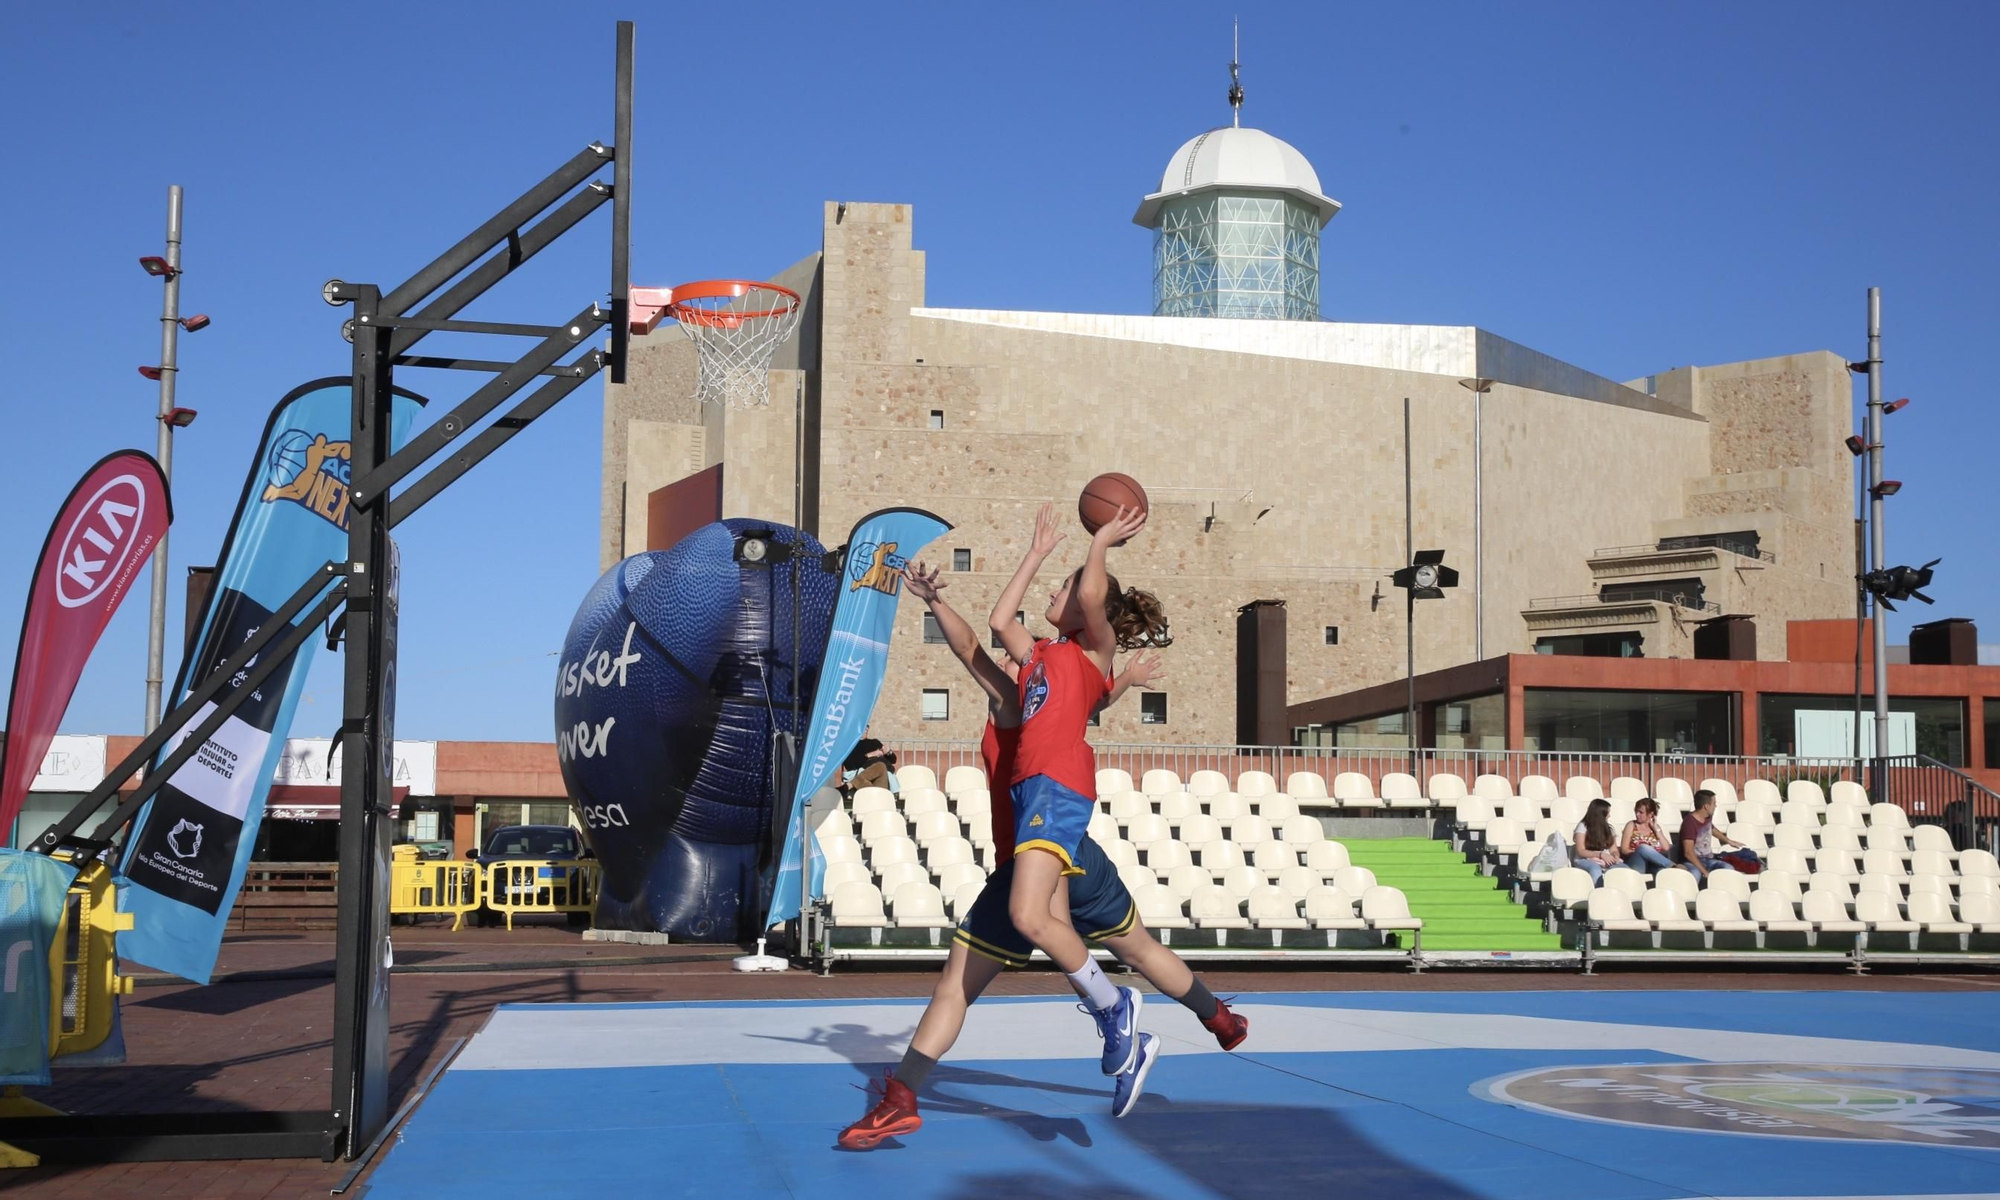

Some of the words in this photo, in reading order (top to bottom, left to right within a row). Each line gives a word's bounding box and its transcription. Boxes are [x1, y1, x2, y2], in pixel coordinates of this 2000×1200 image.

[305, 471, 350, 531] NEX
[62, 499, 137, 590] KIA
[106, 534, 153, 612] www.kiacanarias.es
[556, 621, 641, 698] asket
[559, 717, 616, 763] over
[197, 755, 233, 780] DEPORTES
[188, 877, 218, 892] Deporte
[1616, 1091, 1817, 1128] movistar
